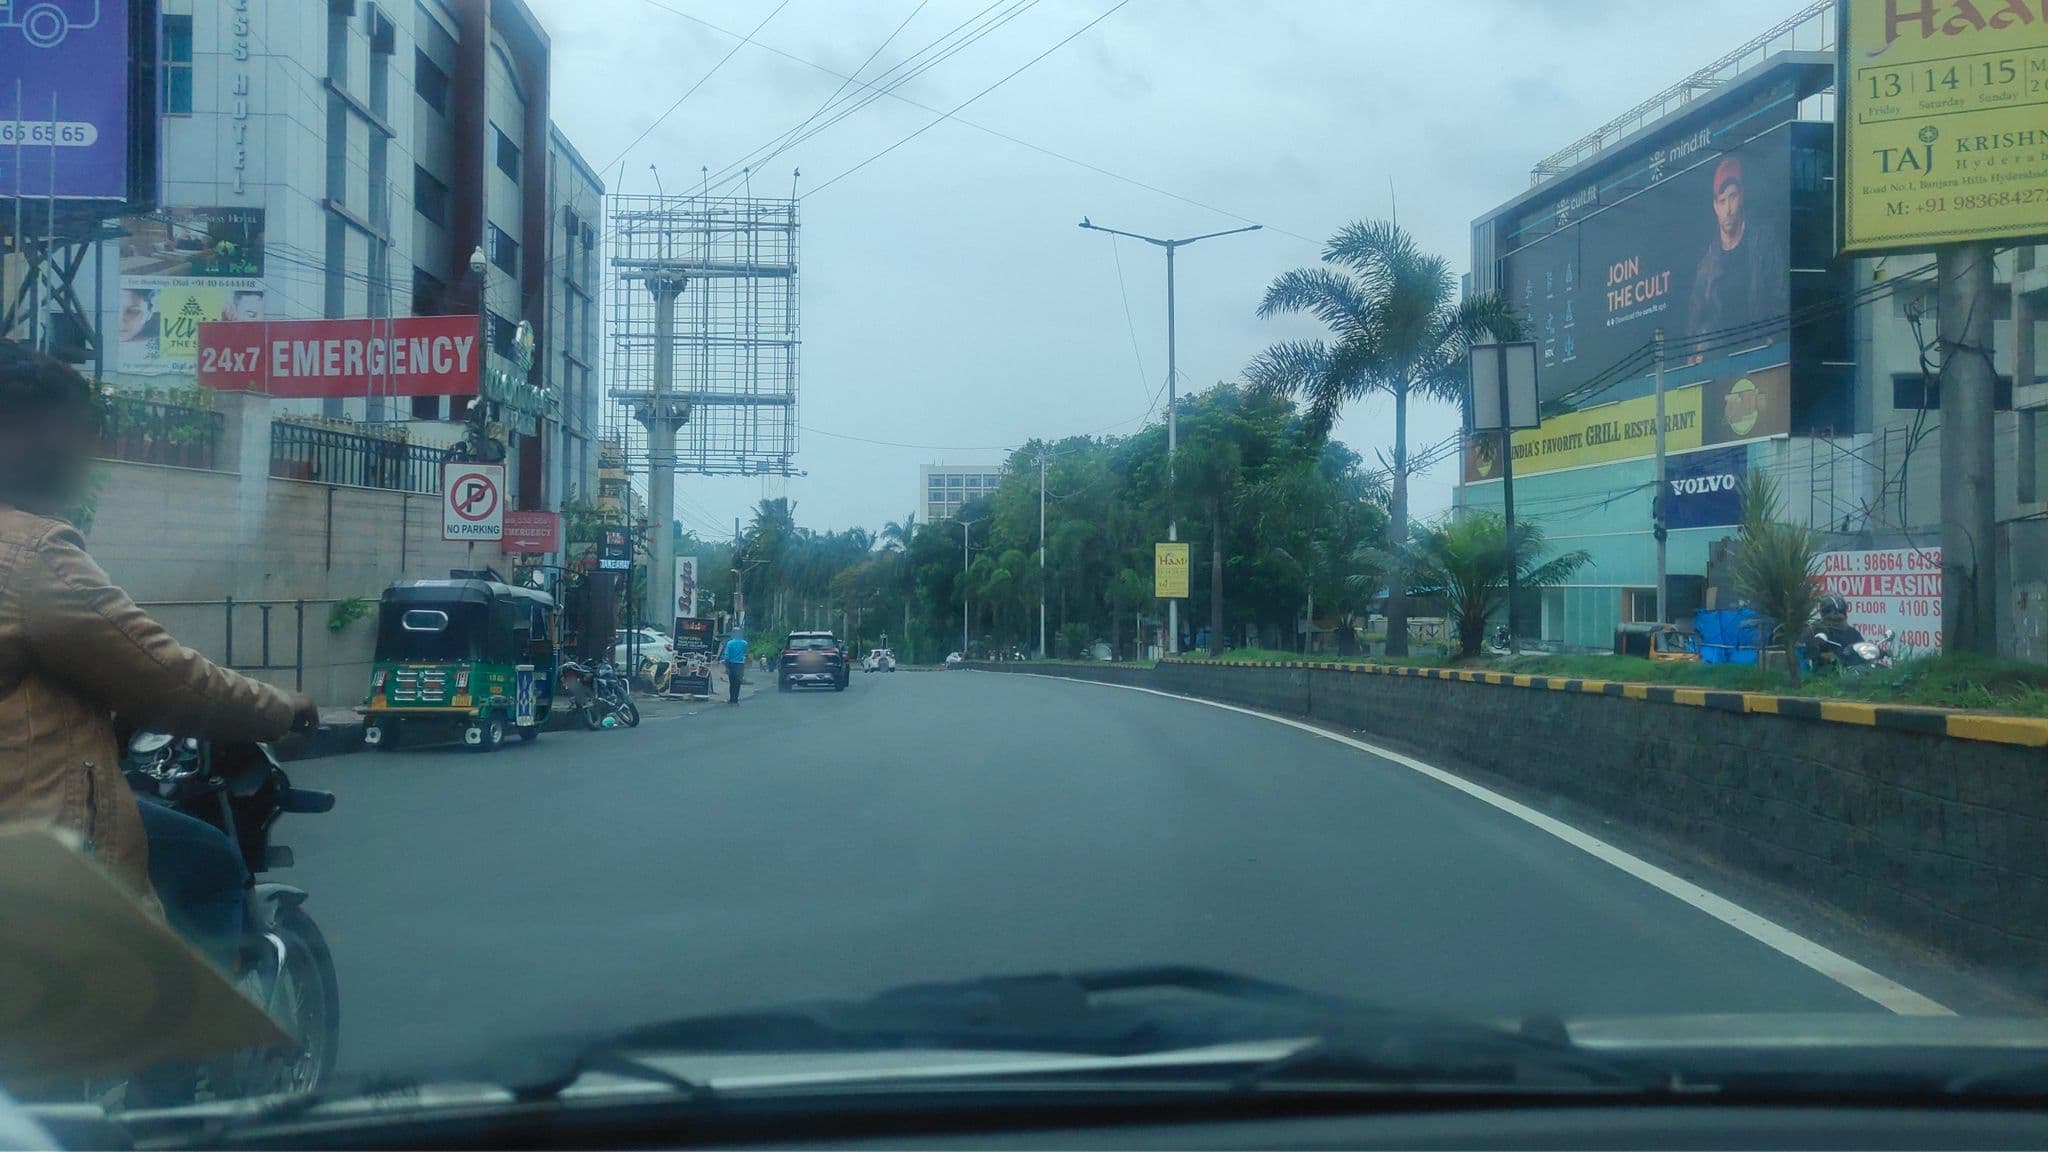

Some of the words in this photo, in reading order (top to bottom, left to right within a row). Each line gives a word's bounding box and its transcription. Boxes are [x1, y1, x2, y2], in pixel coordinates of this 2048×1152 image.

[1869, 73, 1902, 100] 13
[1925, 66, 1960, 93] 14
[1983, 59, 2017, 86] 15
[1868, 105, 1901, 117] Friday
[1919, 96, 1965, 110] Saturday
[1978, 90, 2017, 104] Sunday
[62, 126, 85, 142] 65
[232, 73, 249, 195] HOTEL
[1669, 127, 1712, 163] mind.fit
[1872, 143, 1935, 177] TAJ
[1570, 183, 1598, 210] cult.fit
[1863, 184, 1887, 195] Road
[1920, 178, 1959, 191] Banjara
[1962, 175, 1988, 185] Hills
[1886, 202, 1910, 217] M:
[1916, 197, 1947, 214] +91
[1607, 255, 1640, 287] JOIN
[1607, 288, 1633, 313] THE
[1635, 270, 1671, 303] CULT
[170, 340, 190, 349] THE
[201, 346, 261, 374] 24x7
[272, 335, 475, 378] EMERGENCY
[1541, 431, 1583, 456] FAVORITE
[1585, 420, 1622, 446] GRILL
[1623, 410, 1697, 439] RESTARANT
[1670, 473, 1735, 496] VOLVO
[447, 524, 460, 534] NO
[462, 524, 500, 535] PARKING
[1825, 554, 1853, 572] CALL
[1864, 553, 1904, 572] 98664
[1826, 575, 1865, 596] NOW
[1870, 574, 1942, 596] LEASIN
[1855, 600, 1886, 614] FLOOR
[1899, 599, 1929, 617] 4100
[1900, 630, 1930, 648] 4800
